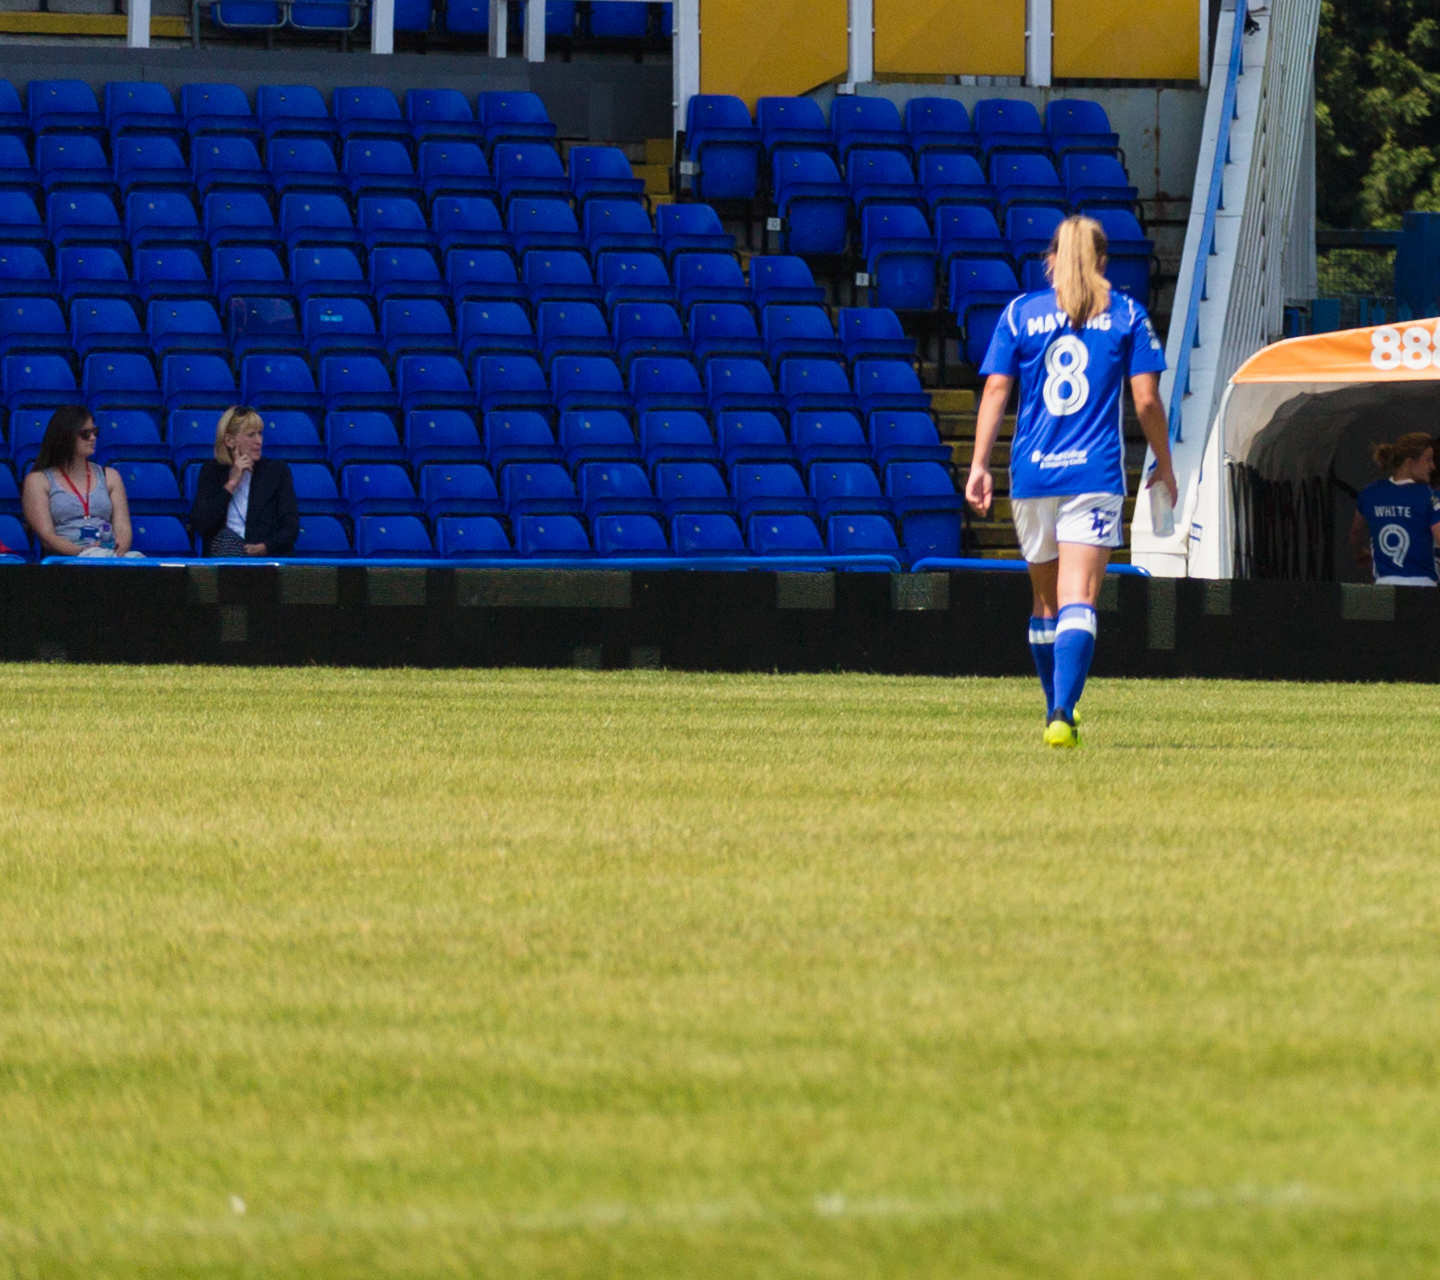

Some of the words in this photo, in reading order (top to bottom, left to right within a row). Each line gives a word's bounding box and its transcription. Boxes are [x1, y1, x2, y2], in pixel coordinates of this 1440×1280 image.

[1043, 334, 1090, 416] 8
[1374, 505, 1411, 518] WHITE
[1378, 523, 1410, 568] 9
